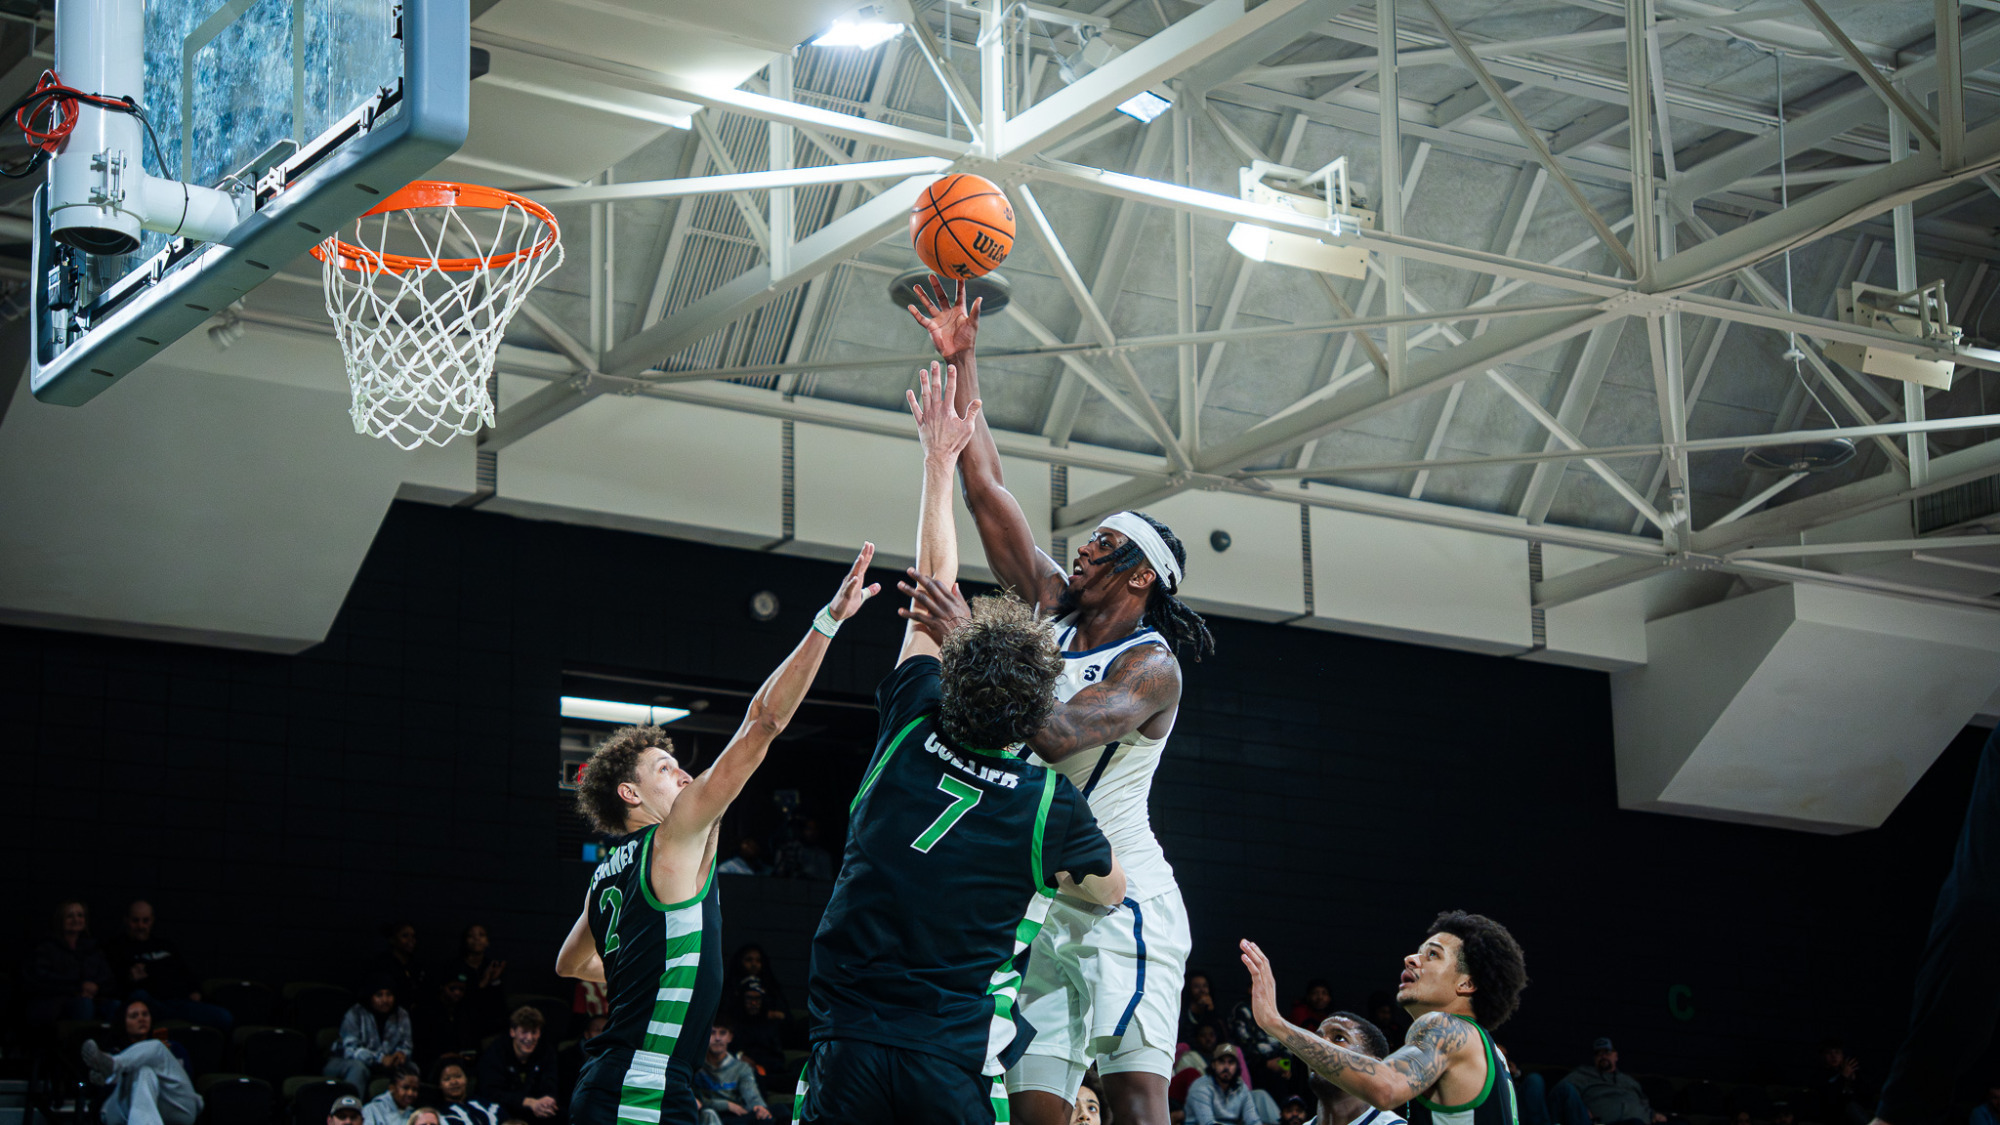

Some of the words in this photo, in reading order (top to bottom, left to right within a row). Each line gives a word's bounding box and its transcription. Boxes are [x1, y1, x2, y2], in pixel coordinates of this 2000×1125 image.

[910, 772, 985, 854] 7
[598, 884, 624, 957] 2
[1666, 983, 1695, 1022] C
